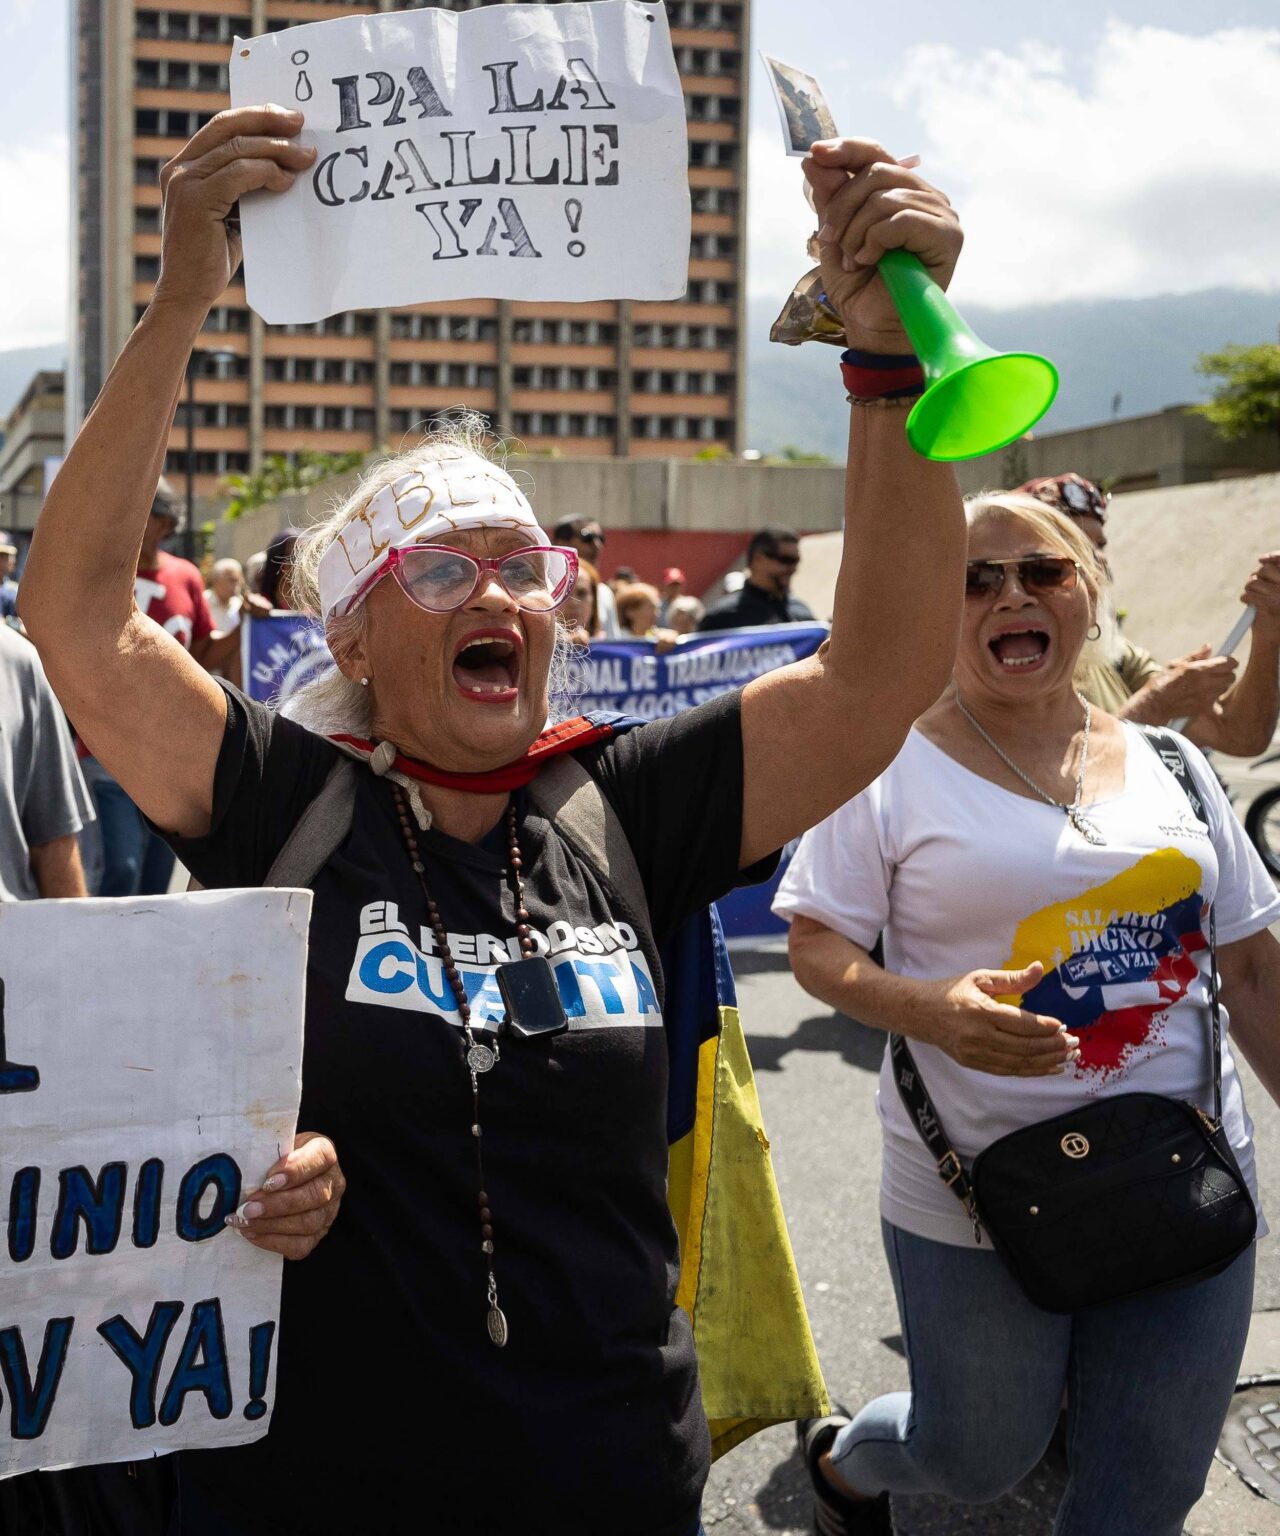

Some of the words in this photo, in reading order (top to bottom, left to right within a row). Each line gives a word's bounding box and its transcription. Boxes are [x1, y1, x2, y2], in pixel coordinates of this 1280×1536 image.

[332, 66, 452, 133] PA
[482, 58, 616, 114] LA
[313, 124, 620, 207] CALLE
[415, 197, 543, 260] YA
[359, 900, 410, 935] EL
[1065, 908, 1168, 931] SALARIO
[1070, 926, 1163, 953] DIGNO
[97, 1296, 276, 1430] YA!
